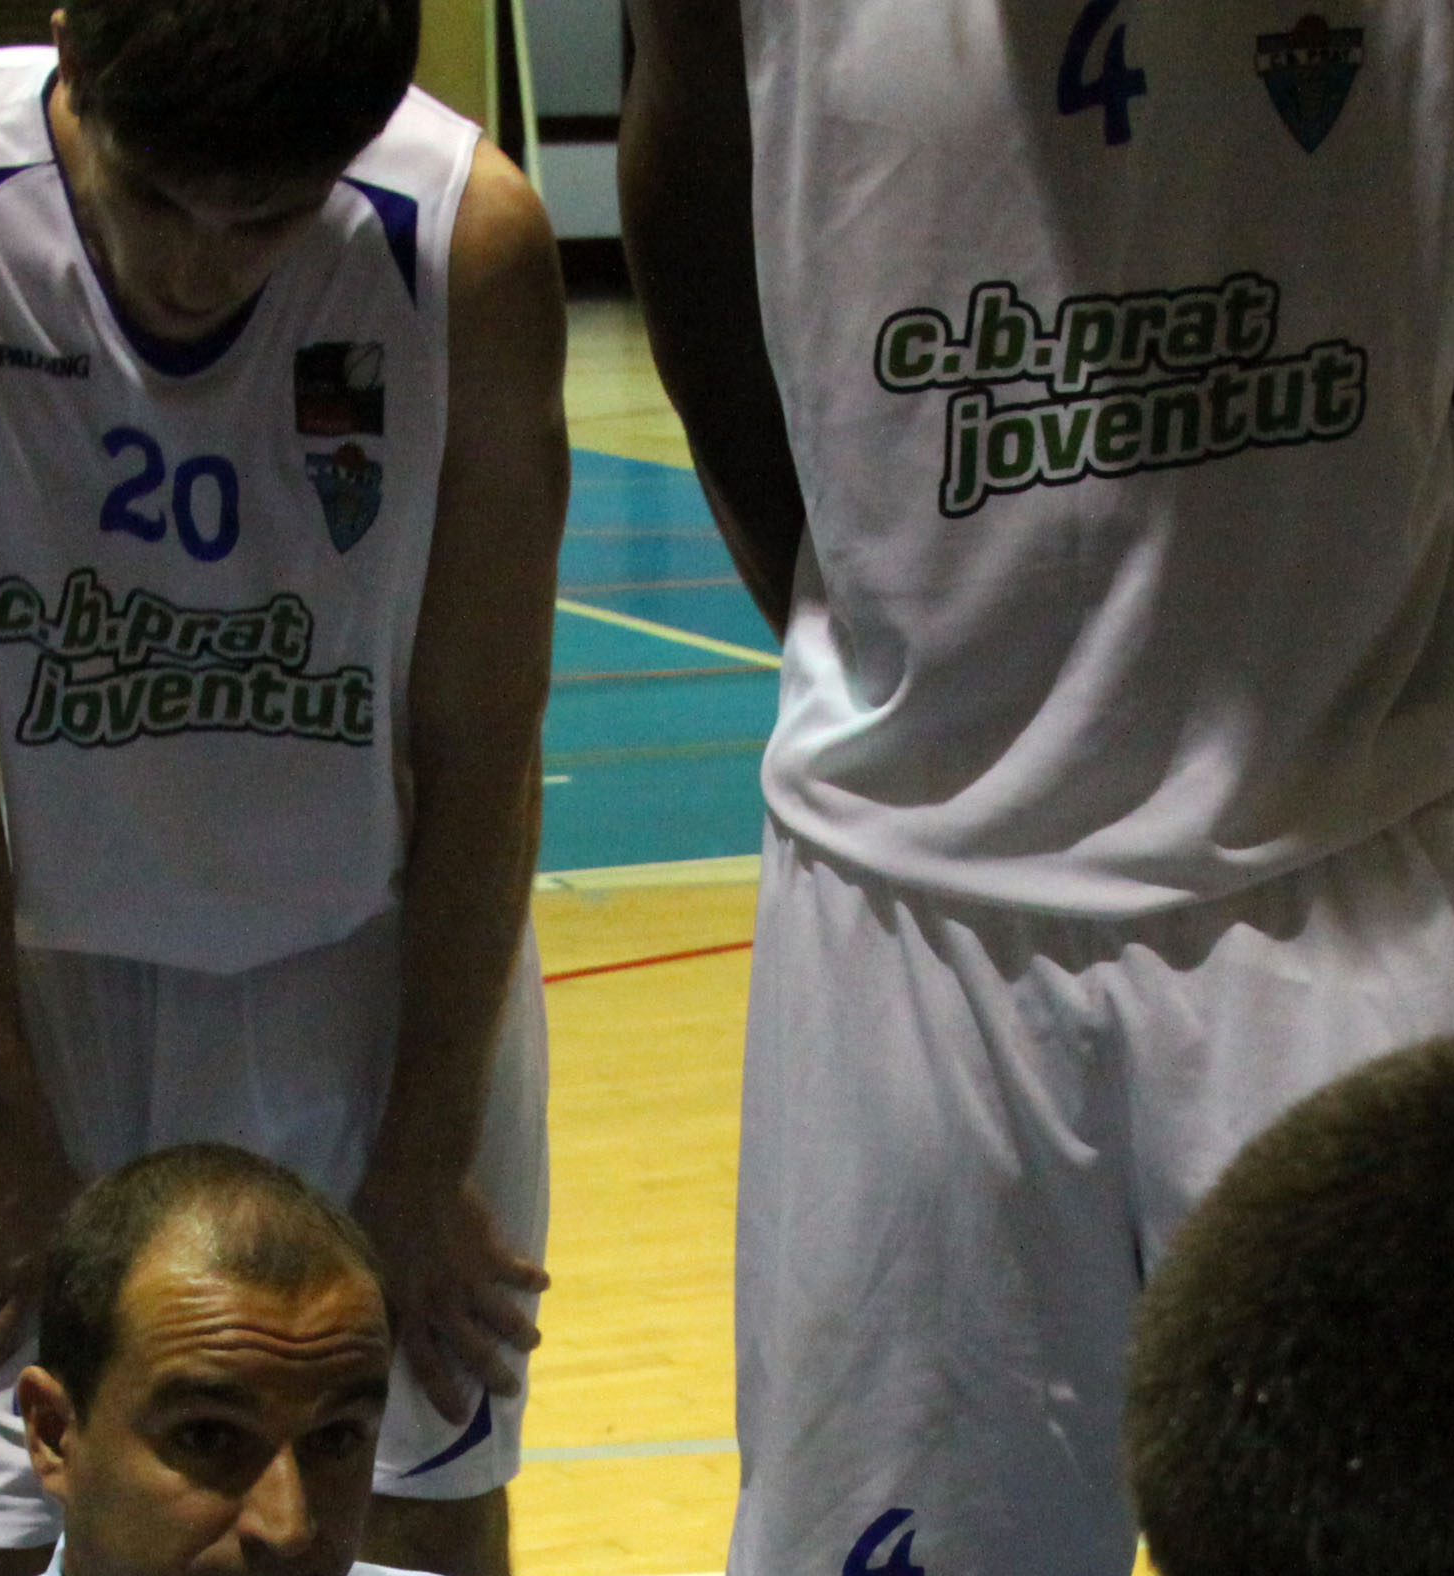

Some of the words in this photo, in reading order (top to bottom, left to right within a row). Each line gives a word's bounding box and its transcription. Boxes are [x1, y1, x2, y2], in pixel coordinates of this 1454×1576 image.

[1058, 0, 1147, 146] 4
[100, 426, 239, 562] 20
[947, 348, 1360, 510] joventut
[23, 658, 373, 742] joventut
